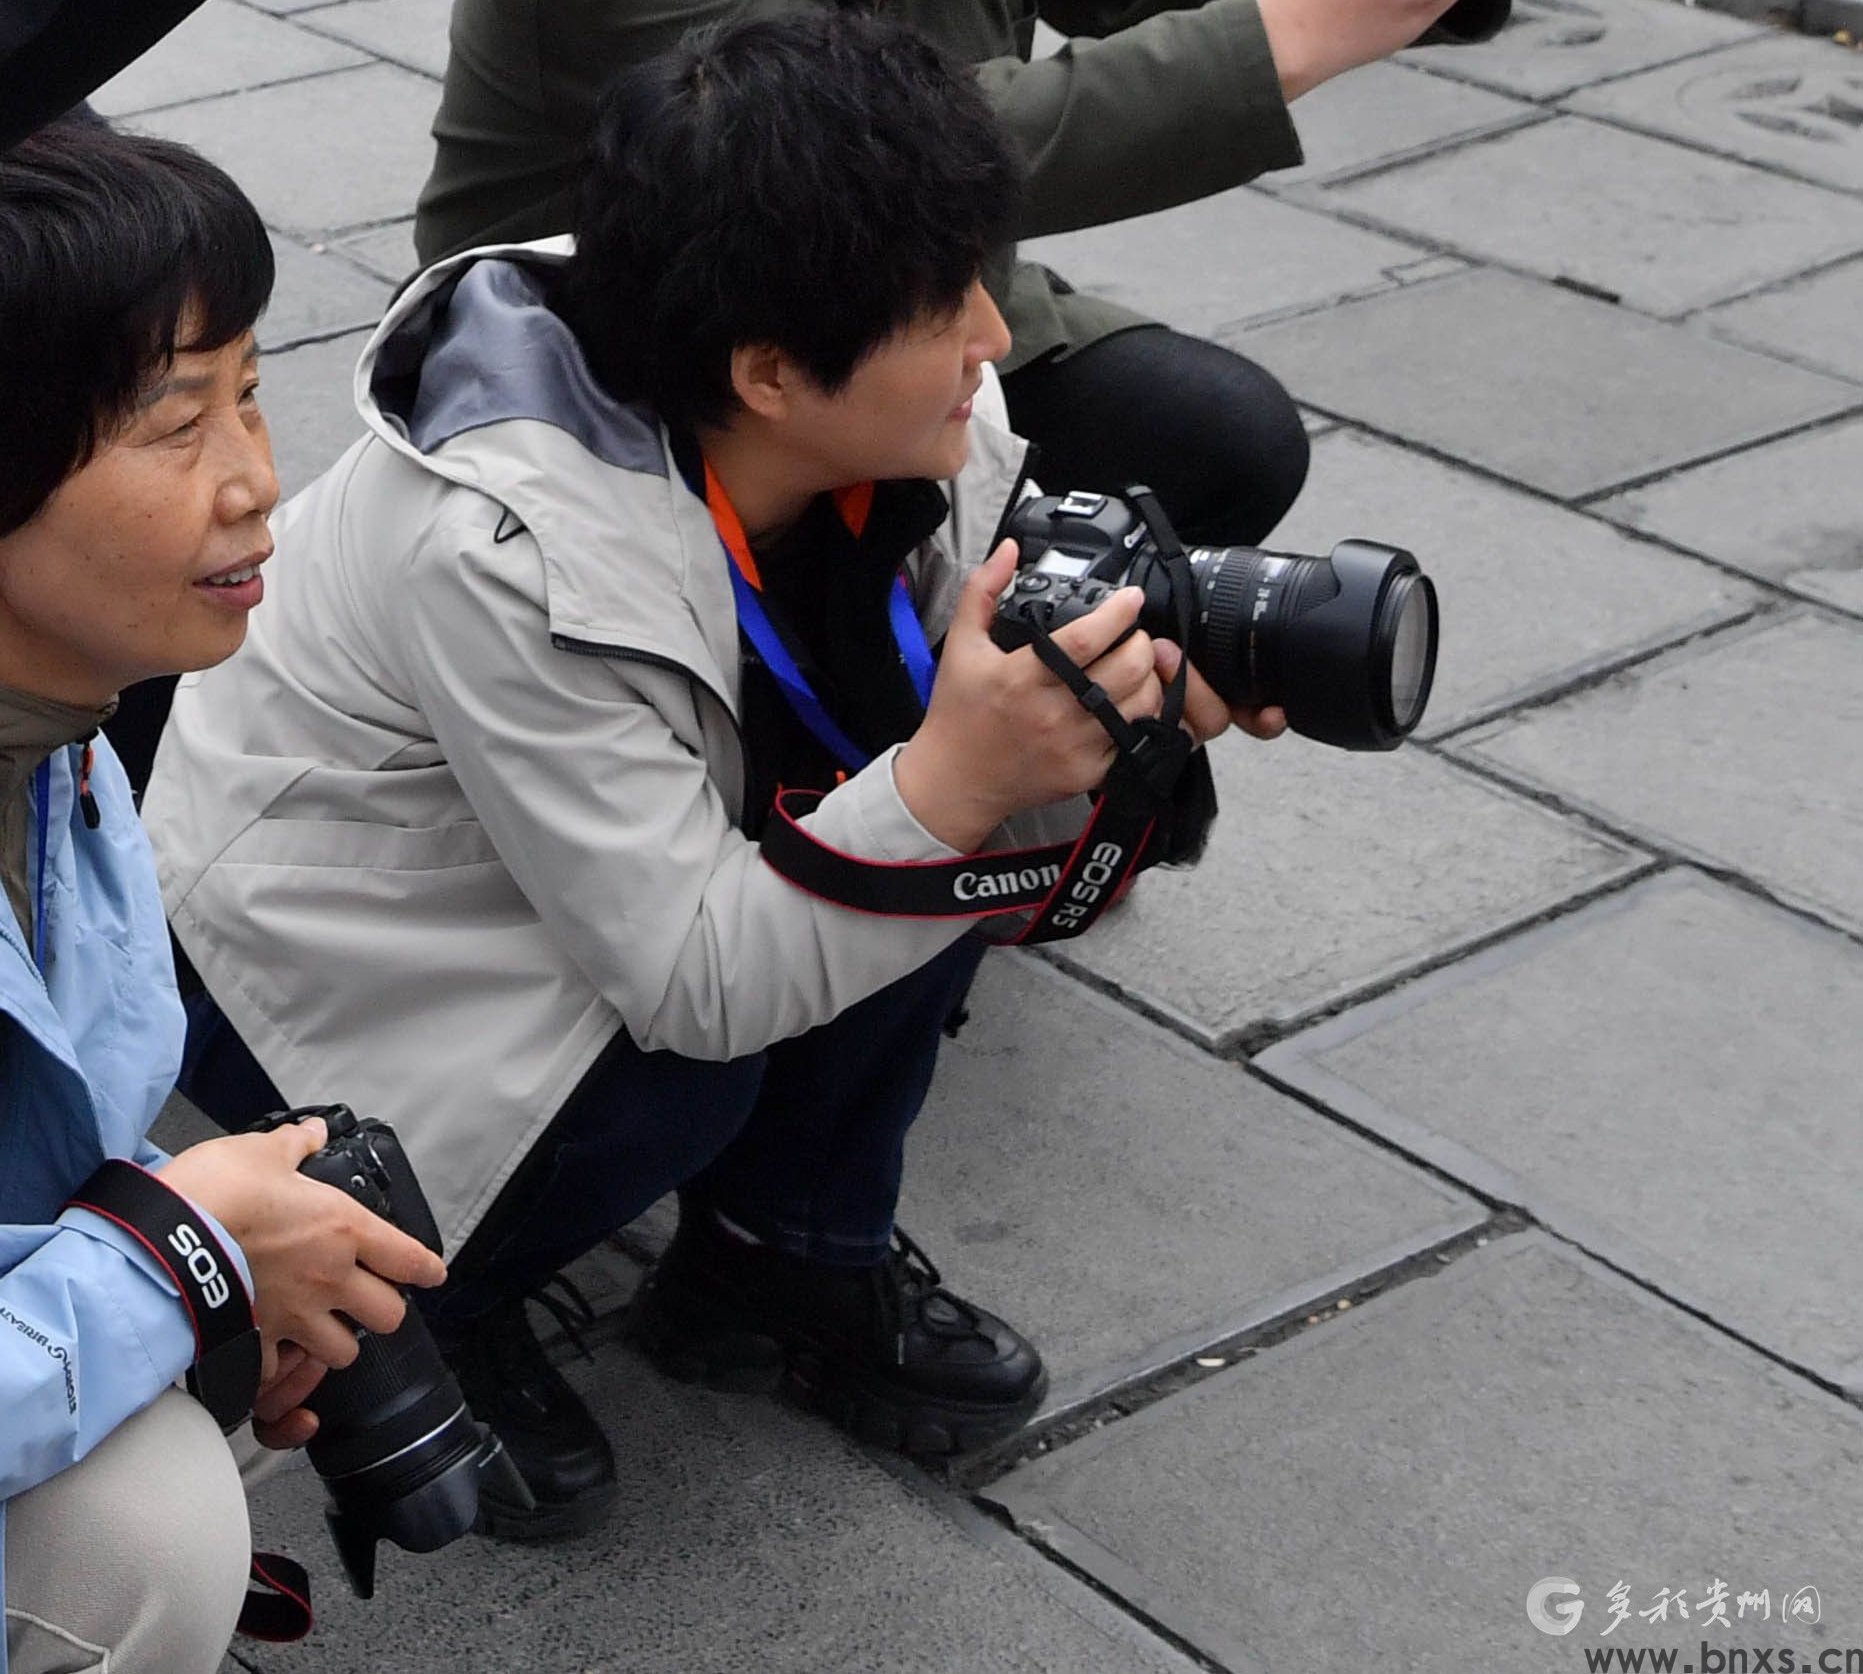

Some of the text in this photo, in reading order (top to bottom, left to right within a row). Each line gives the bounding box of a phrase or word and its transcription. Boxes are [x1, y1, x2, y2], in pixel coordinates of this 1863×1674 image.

[953, 864, 1062, 901] Canon
[1051, 842, 1123, 929] EOS R5
[167, 1223, 230, 1309] EOS
